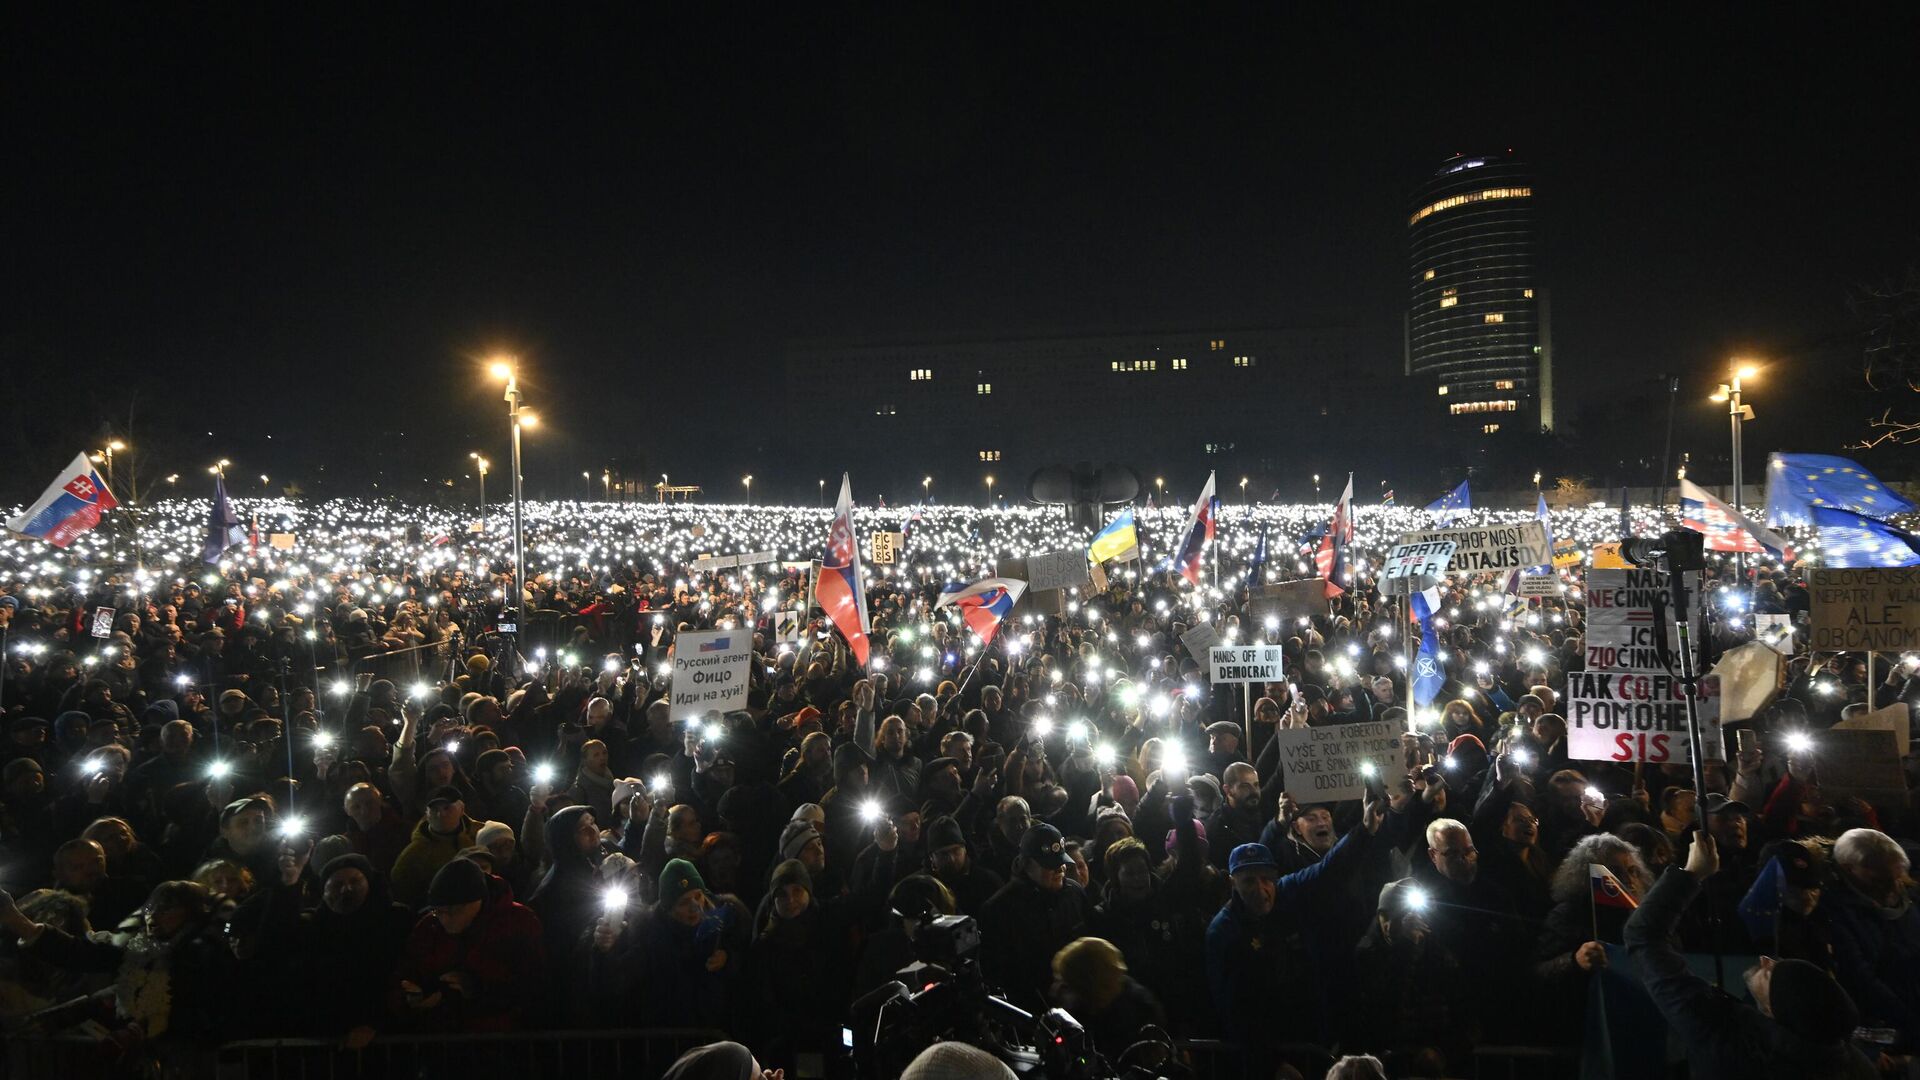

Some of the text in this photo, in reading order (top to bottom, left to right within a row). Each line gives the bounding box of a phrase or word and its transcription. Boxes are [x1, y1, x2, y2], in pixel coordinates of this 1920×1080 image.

[1445, 546, 1520, 571] EUTAJÍŠ
[1847, 605, 1902, 625] ALE
[676, 653, 750, 671] Русский агент
[1213, 649, 1280, 663] HANDS OFF OUR
[692, 670, 732, 684] Фицо
[1219, 665, 1278, 679] DEMOCRACY
[676, 684, 744, 705] Иди на хуй!
[1569, 673, 1614, 700] TAK
[1310, 728, 1335, 741] Don
[1286, 742, 1316, 758] VYŠE
[1323, 742, 1342, 756] ROK
[1611, 732, 1671, 762] SIS
